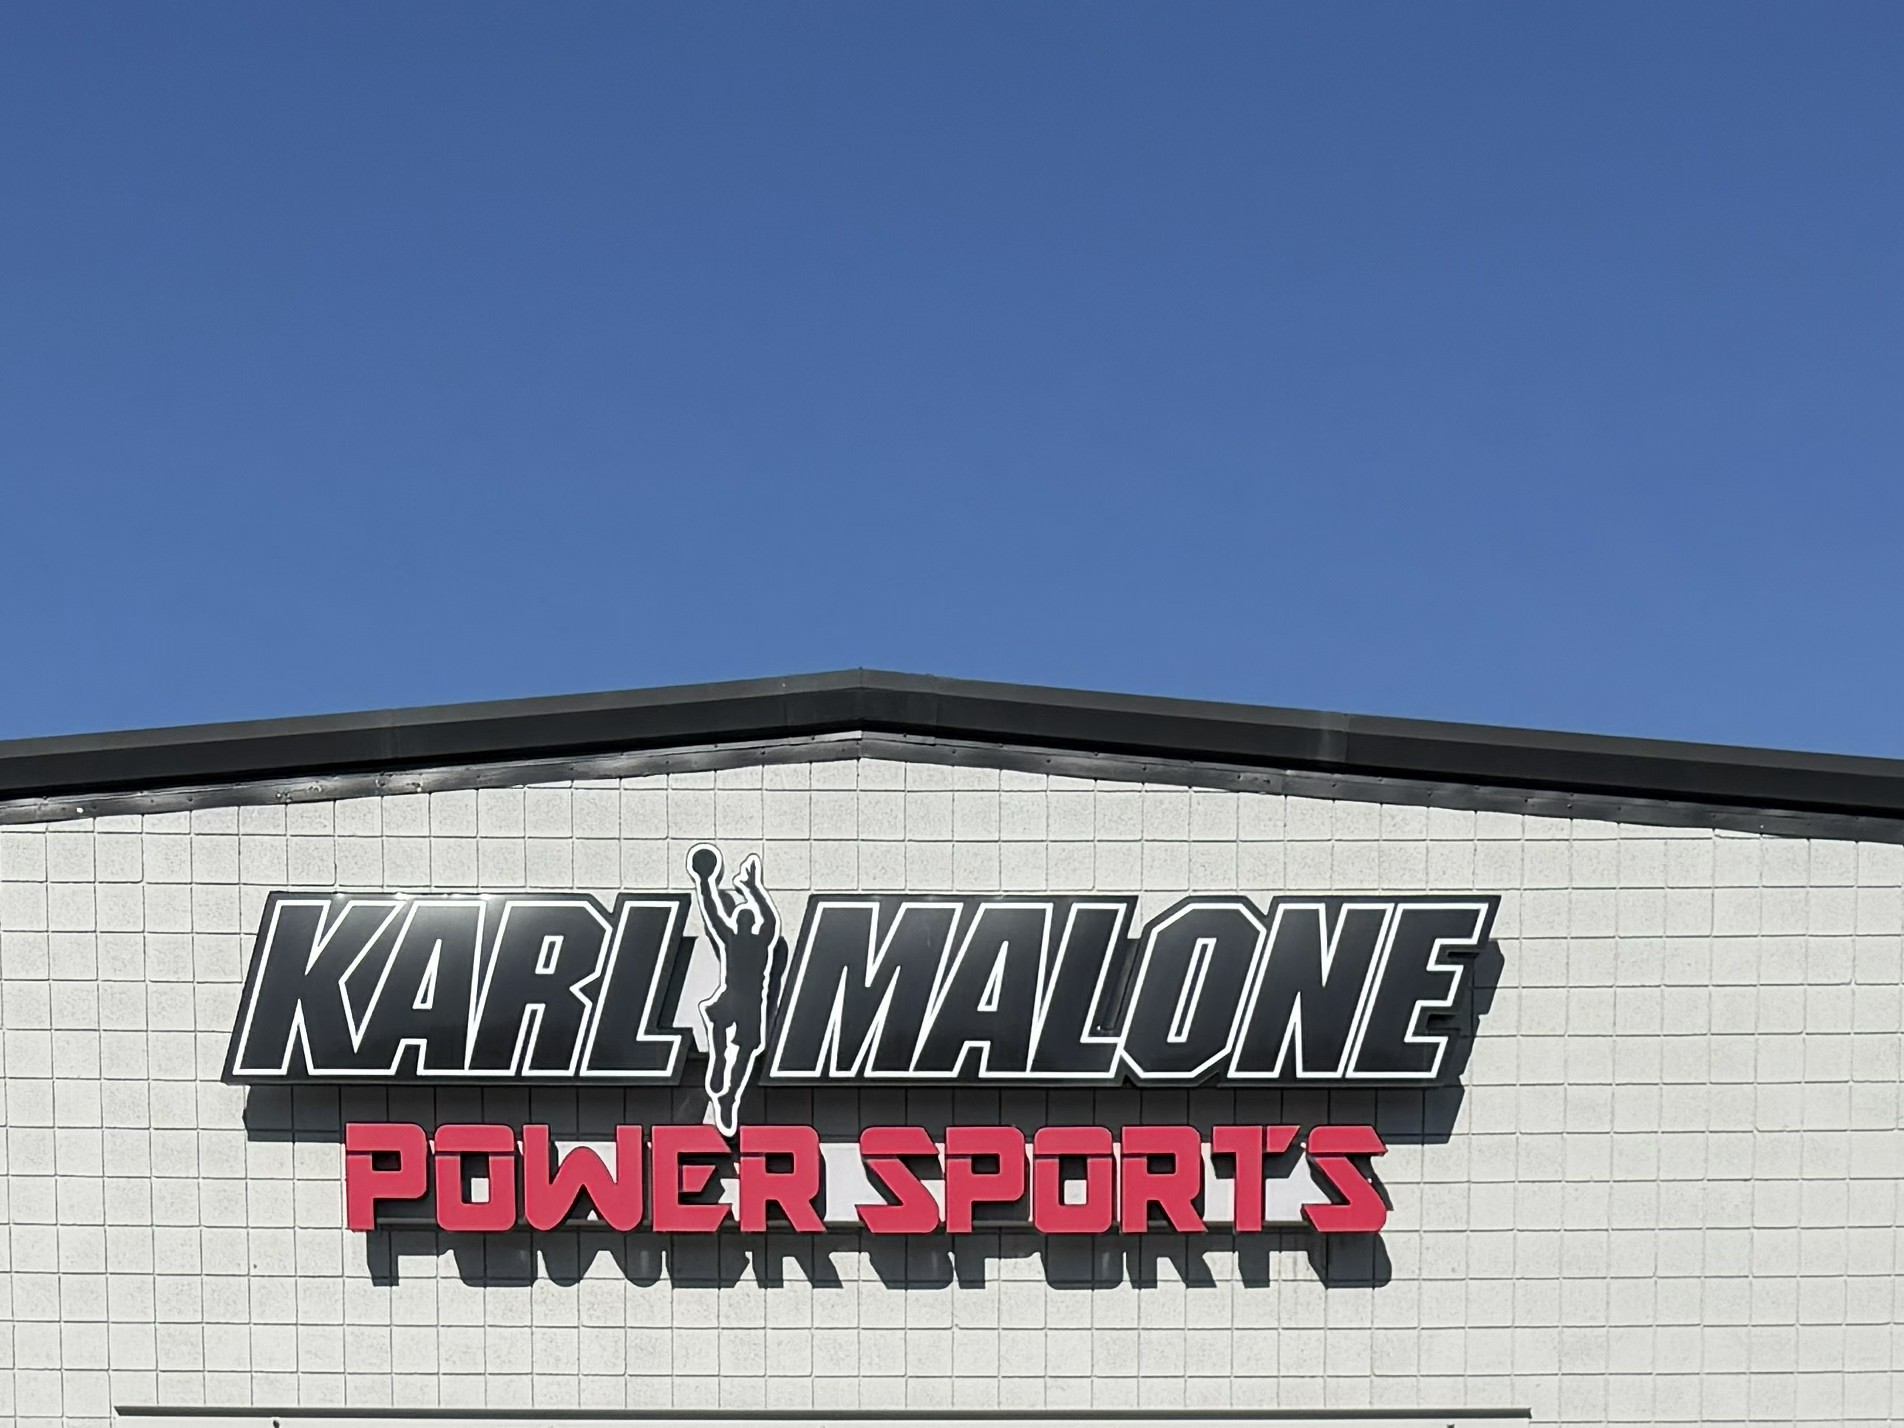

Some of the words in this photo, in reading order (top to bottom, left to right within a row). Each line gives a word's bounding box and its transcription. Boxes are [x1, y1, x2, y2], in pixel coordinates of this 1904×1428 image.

[230, 897, 688, 1080] KARL
[768, 897, 1492, 1081] MALONE
[344, 1122, 830, 1234] POWER
[856, 1123, 1390, 1235] SPORTS
